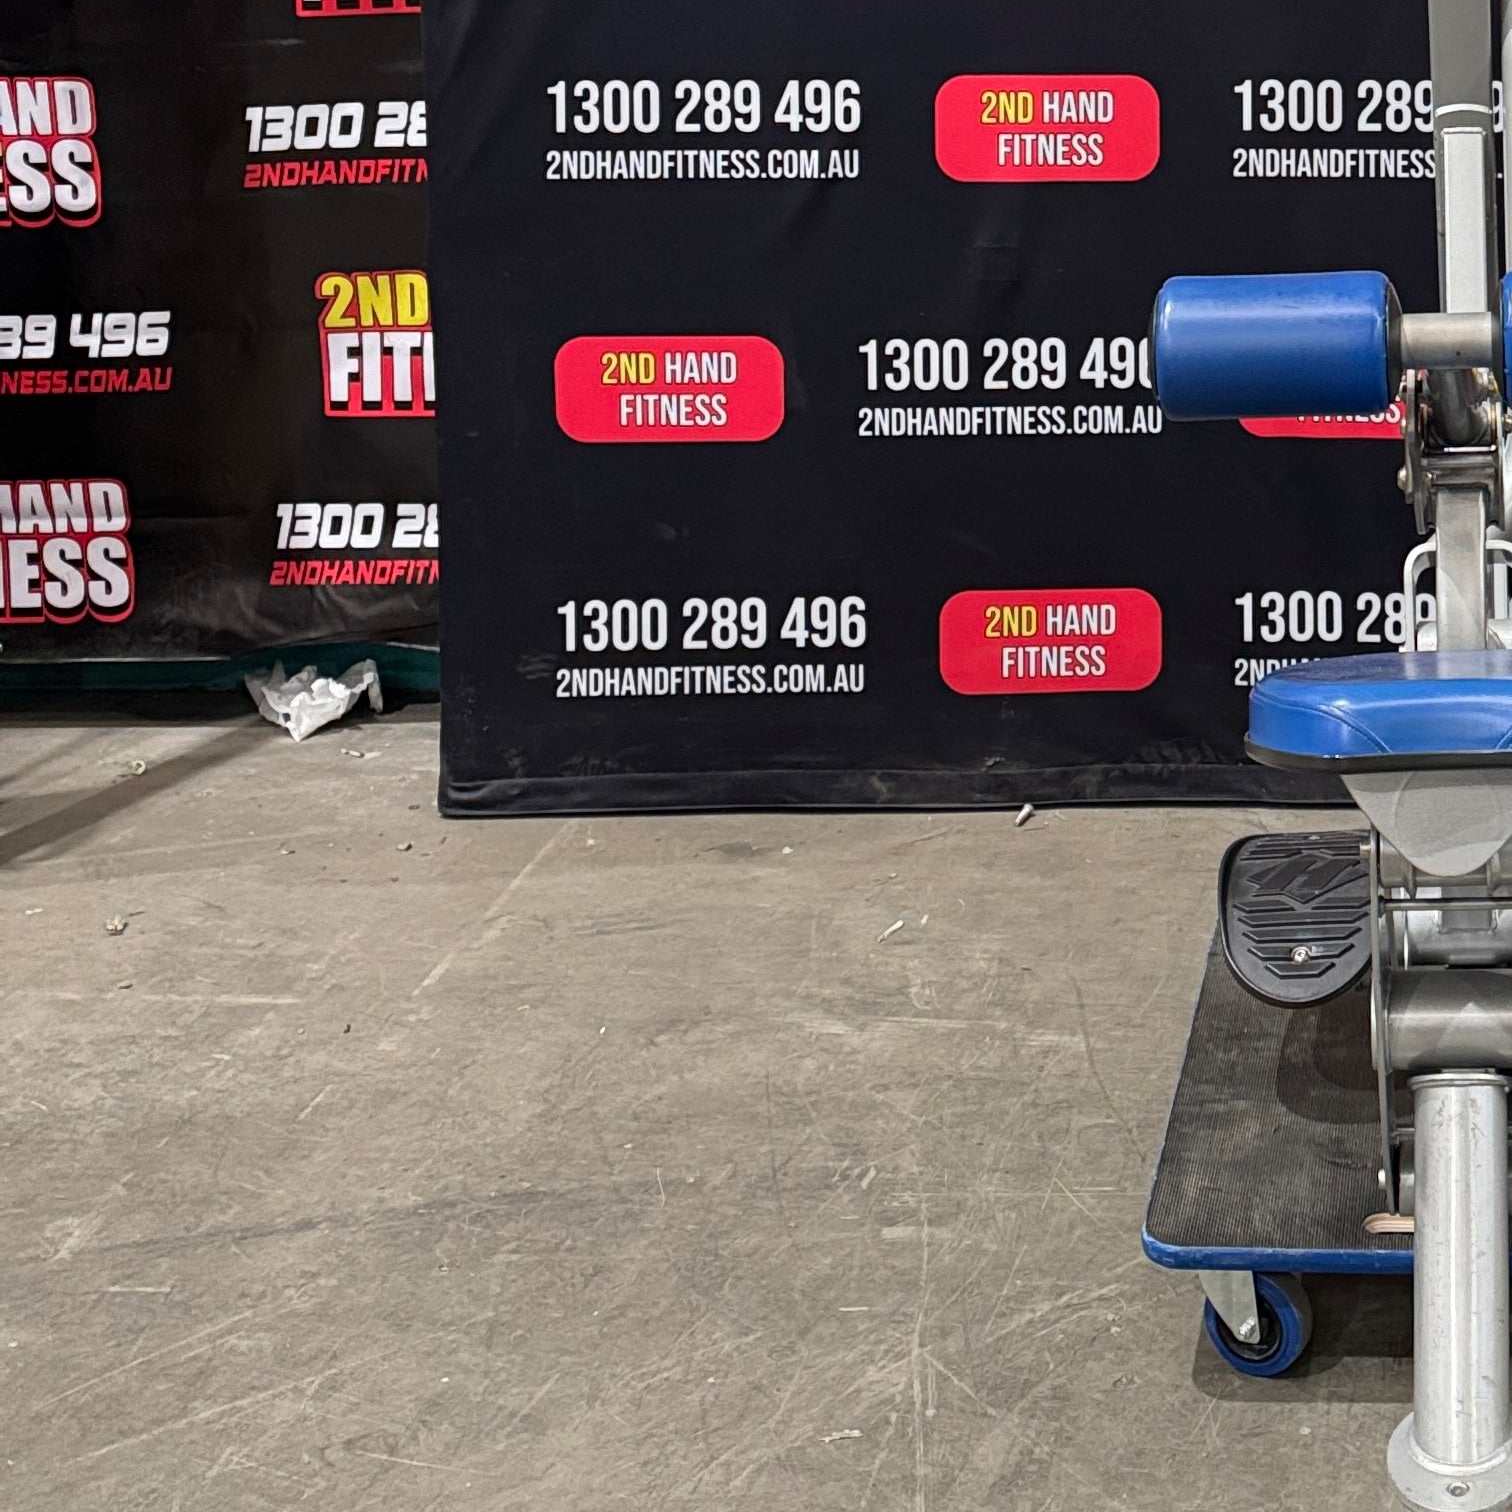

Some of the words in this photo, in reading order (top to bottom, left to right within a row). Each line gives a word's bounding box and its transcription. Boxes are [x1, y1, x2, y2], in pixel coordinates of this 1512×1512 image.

[547, 80, 659, 133] 1300
[675, 80, 760, 132] 289
[775, 80, 860, 132] 496
[982, 92, 1032, 123] 2ND
[1044, 92, 1113, 122] HAND
[1234, 79, 1342, 131] 1300
[1358, 79, 1433, 132] 289
[246, 102, 364, 152] 1300
[547, 150, 858, 179] 2NDHANDFITNESS.COM.AU
[999, 134, 1103, 165] FITNESS
[322, 274, 428, 327] 2ND
[70, 311, 170, 357] 496
[602, 353, 654, 383] 2ND
[666, 352, 736, 383] HAND
[859, 339, 968, 390] 1300
[984, 337, 1066, 389] 289
[621, 394, 726, 425] FITNESS
[859, 406, 1162, 436] 2NDHANDFITNESS.COM.AU
[277, 503, 384, 548] 1300
[558, 599, 667, 651] 1300
[683, 597, 766, 649] 289
[781, 596, 865, 647] 496
[986, 607, 1036, 636] 2ND
[1047, 605, 1115, 635] HAND
[1235, 591, 1342, 642] 1300
[557, 664, 863, 697] 2NDHANDFITNESS.COM.AU
[1003, 646, 1105, 677] FITNESS
